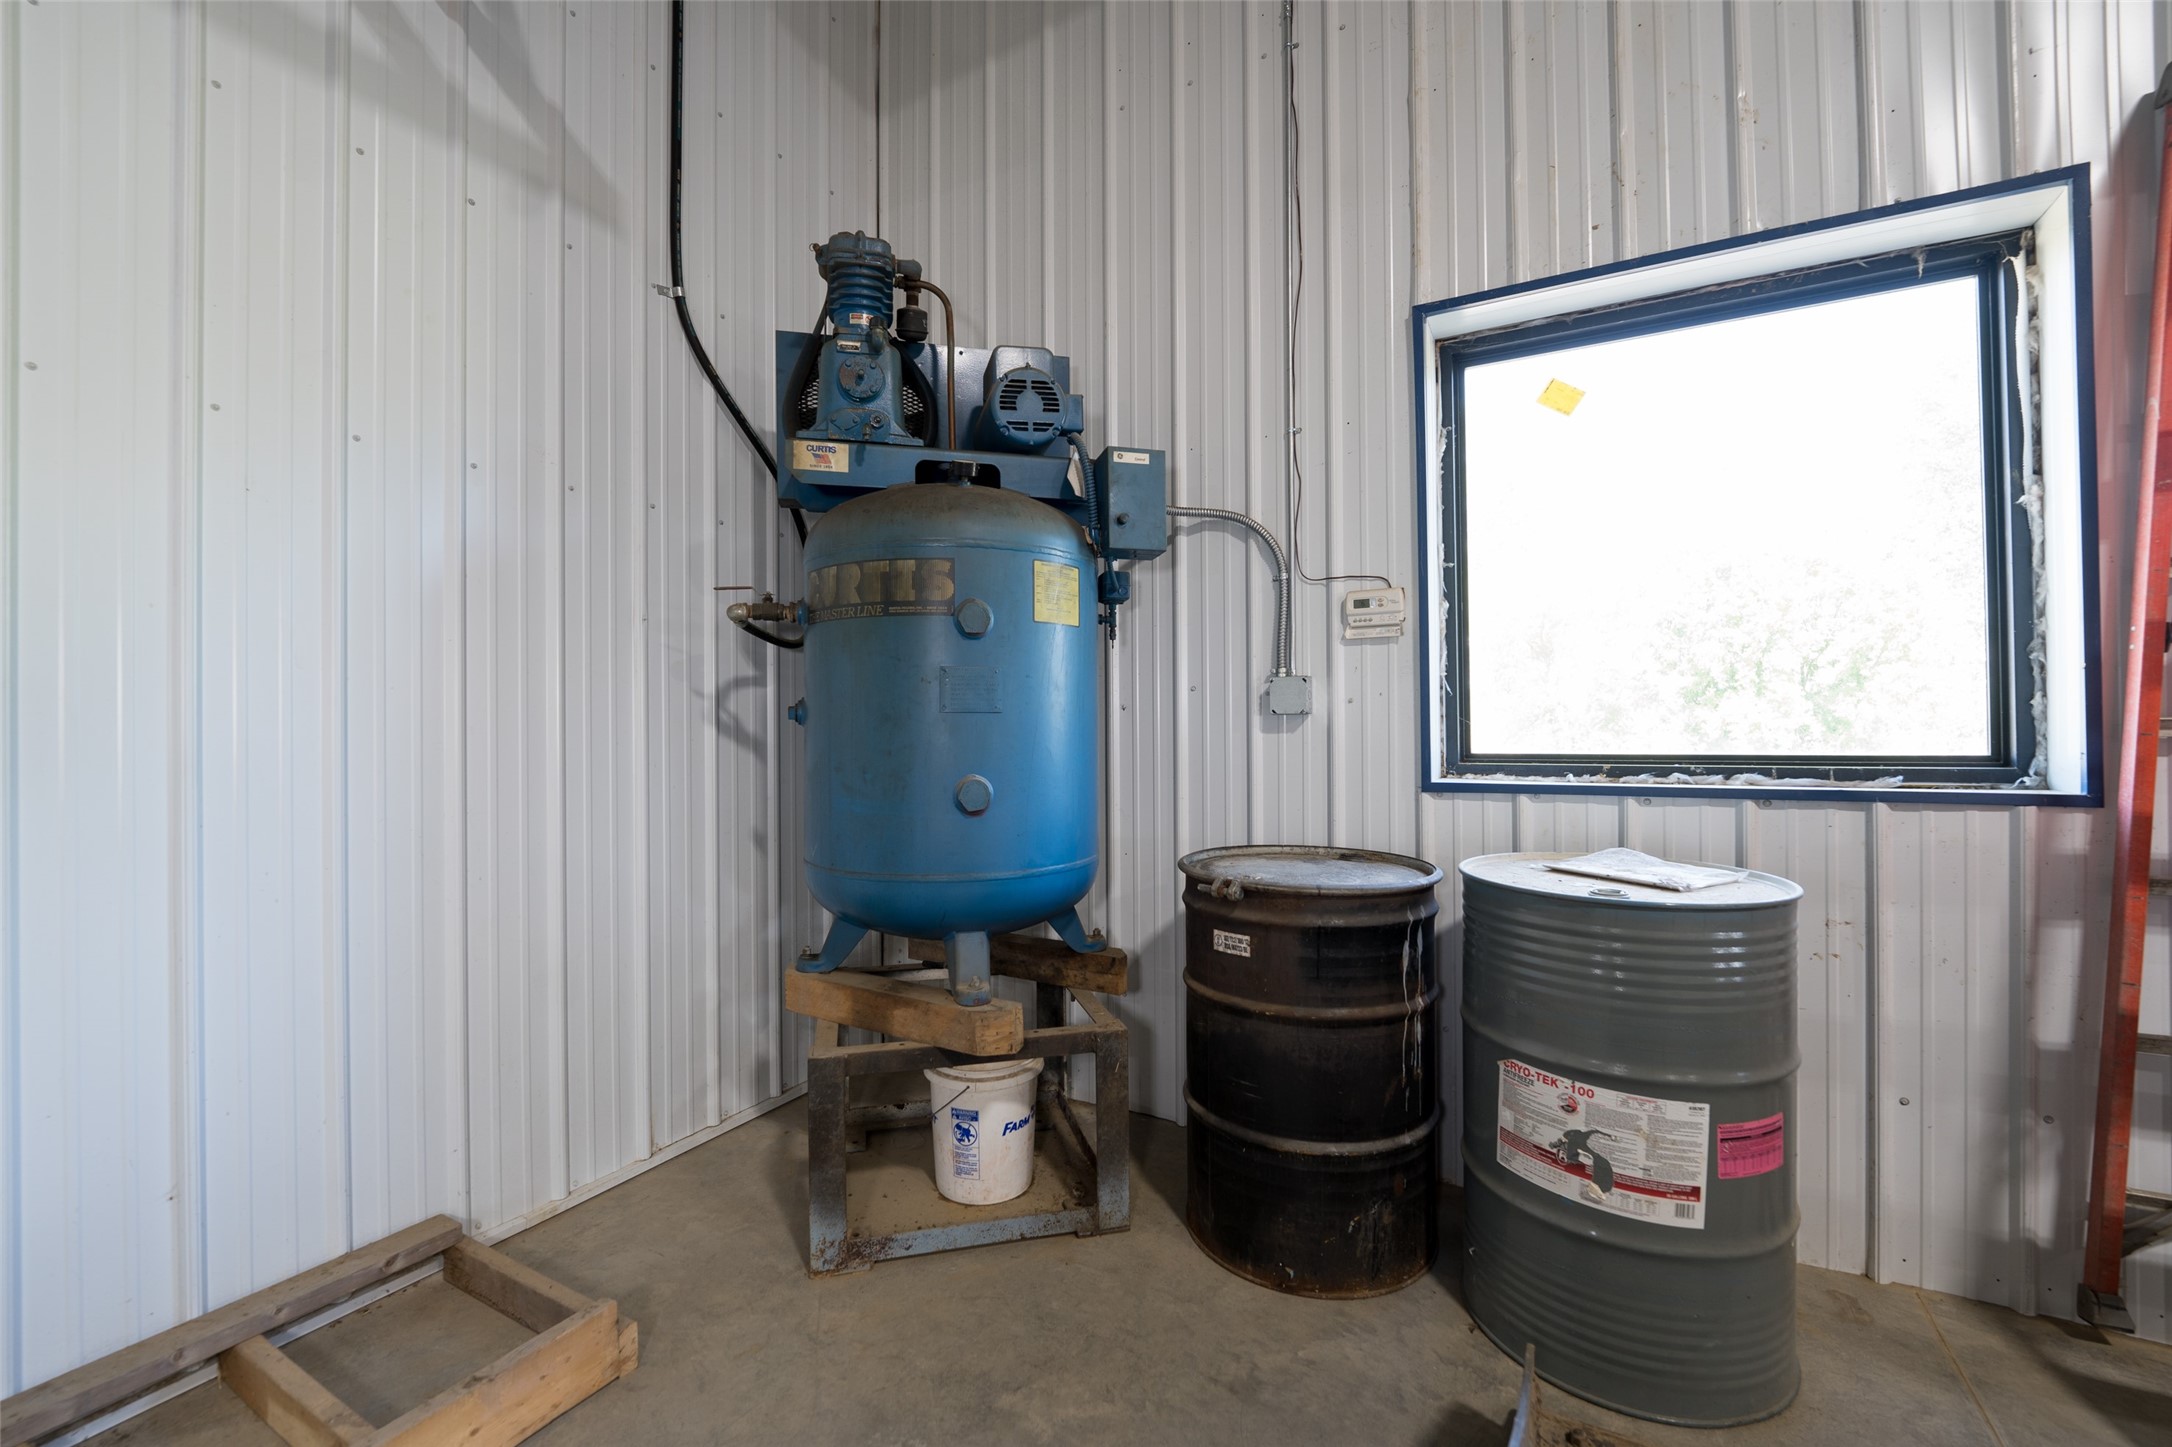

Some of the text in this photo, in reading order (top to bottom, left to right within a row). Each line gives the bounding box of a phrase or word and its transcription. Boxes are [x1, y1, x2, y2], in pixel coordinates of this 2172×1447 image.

[806, 444, 837, 454] CURTIS
[808, 559, 955, 609] CURTIS
[857, 604, 885, 617] LINE
[1503, 1067, 1535, 1087] ANTIFREEZE
[1002, 1114, 1030, 1136] FARM
